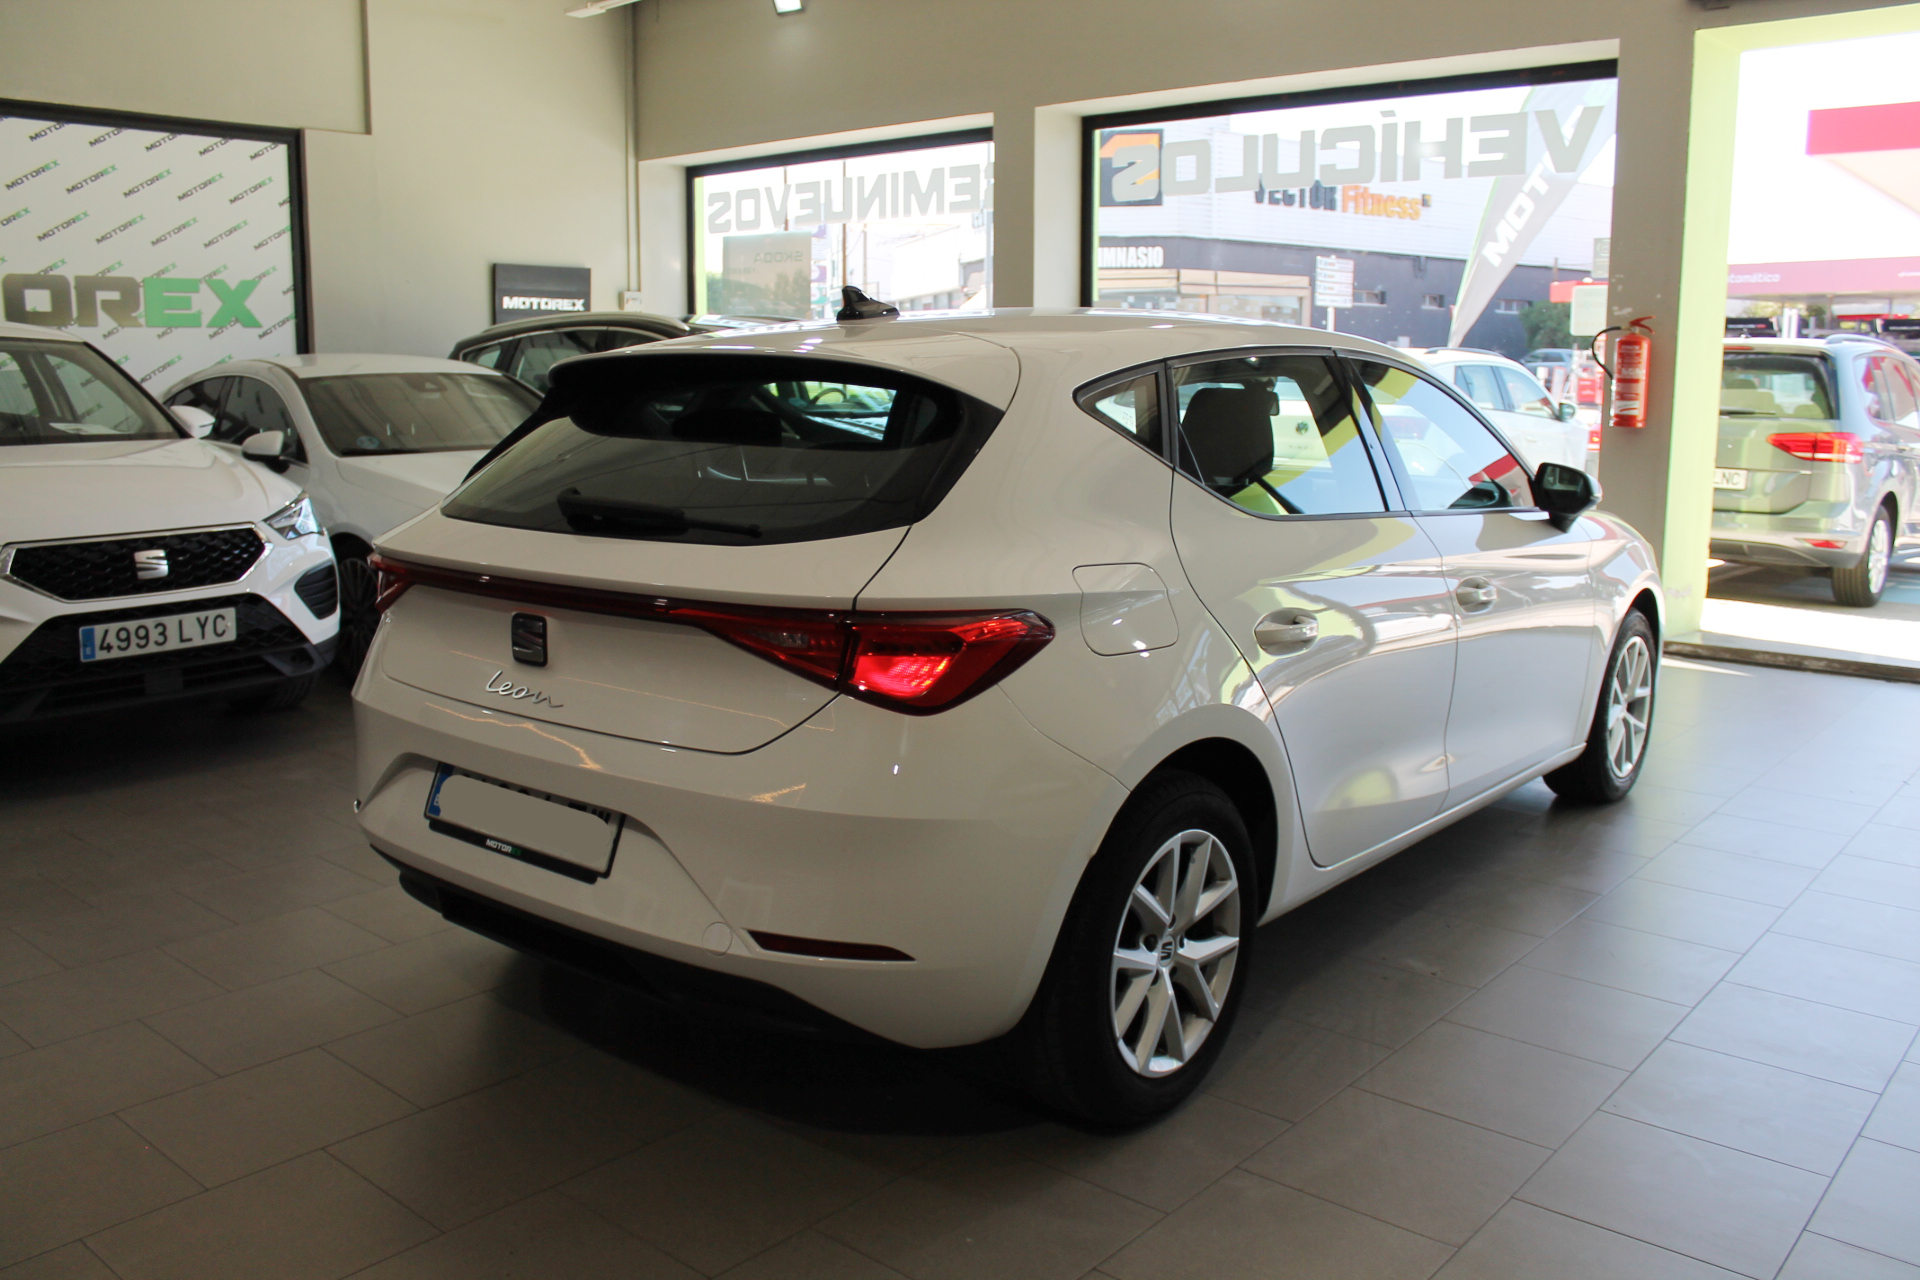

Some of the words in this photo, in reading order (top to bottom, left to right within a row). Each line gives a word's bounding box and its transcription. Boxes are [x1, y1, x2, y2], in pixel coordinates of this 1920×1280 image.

[88, 127, 130, 148] MOTO
[5, 160, 60, 190] MOTOREX
[66, 164, 118, 194] MOTOREX
[123, 169, 172, 198] MOTOREX
[177, 173, 224, 201] MOTOREX
[229, 177, 274, 204] MOTOREX
[1342, 185, 1421, 220] Fitness
[37, 211, 90, 242] MOTOREX
[96, 214, 146, 244] MOTOREX
[150, 217, 198, 247] MOTOREX
[203, 220, 249, 249] MOTOREX
[3, 273, 263, 328] OREX
[502, 295, 586, 312] MOTOREX
[99, 622, 168, 653] 4993
[179, 613, 227, 643] LYC
